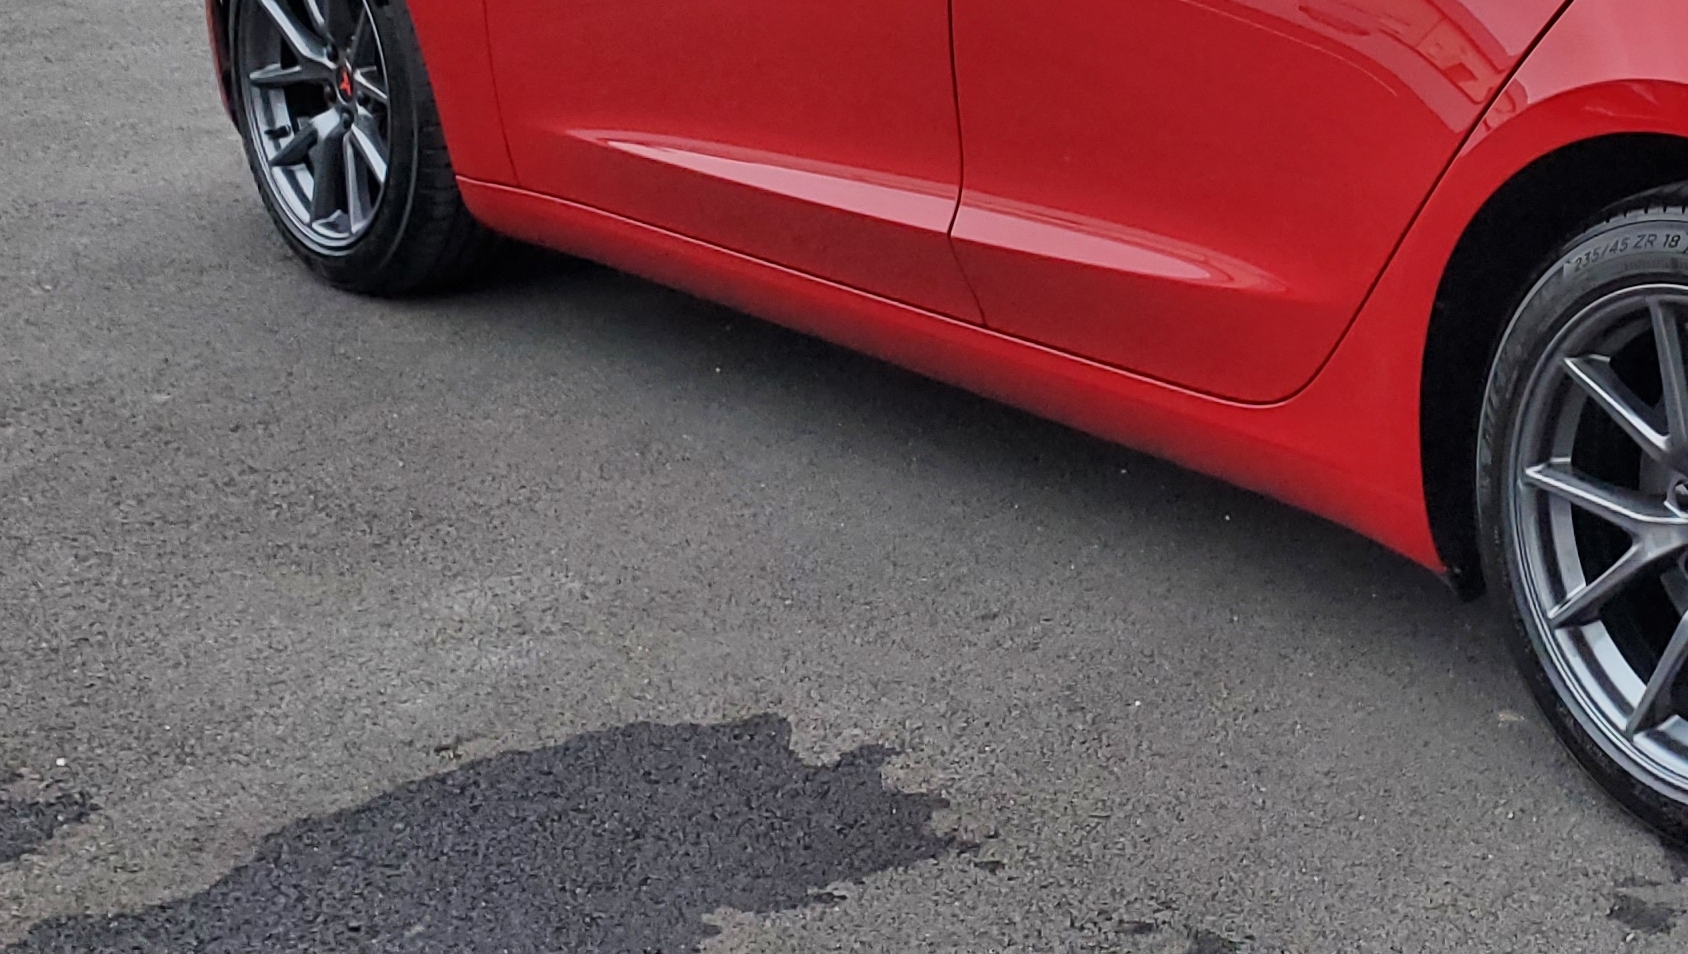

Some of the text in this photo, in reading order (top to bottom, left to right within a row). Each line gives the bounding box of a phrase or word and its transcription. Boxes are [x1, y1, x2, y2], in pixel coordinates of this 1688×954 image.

[1575, 233, 1681, 272] 235/45 ZR 18
